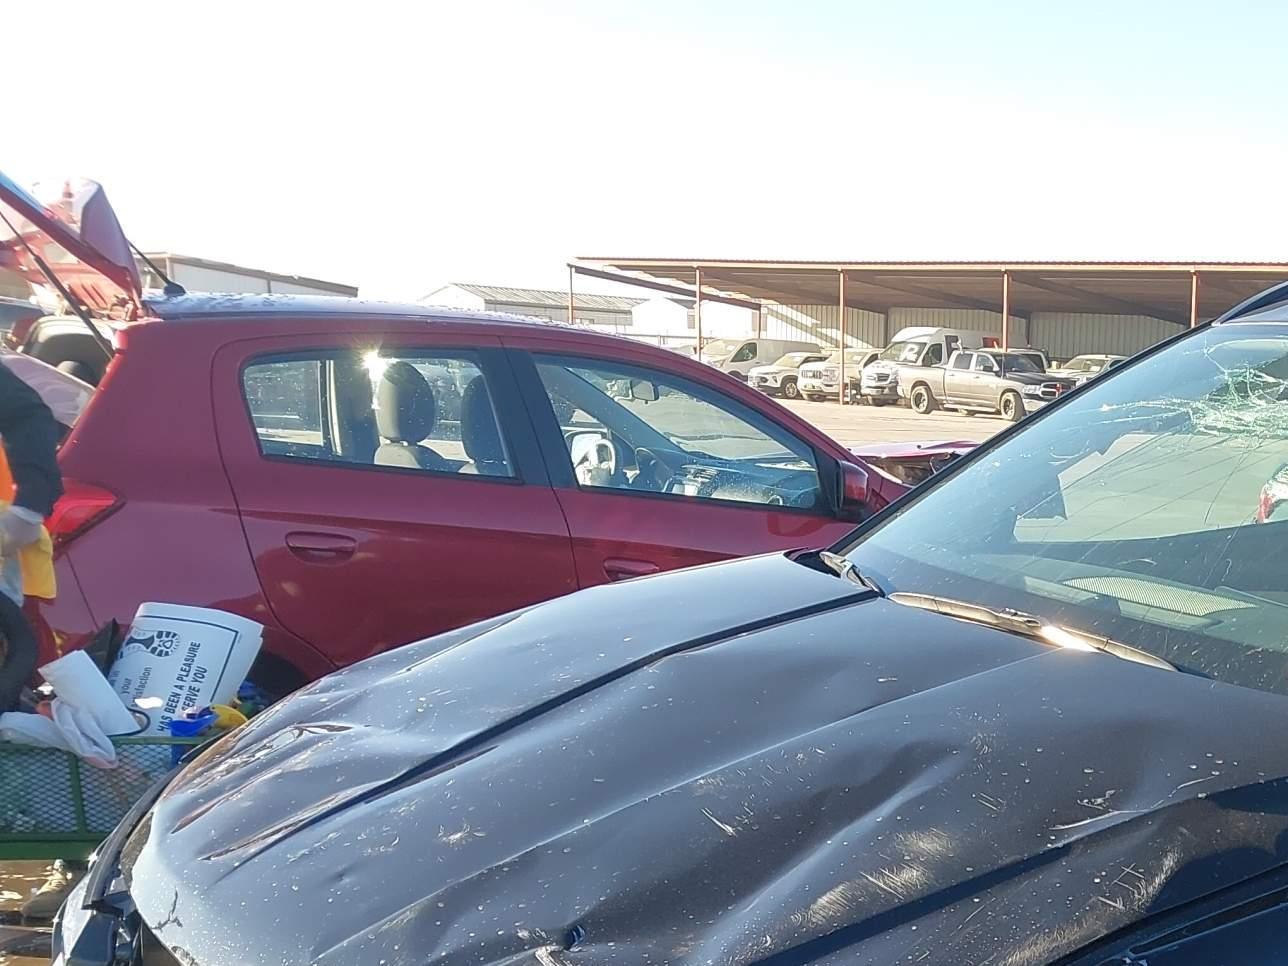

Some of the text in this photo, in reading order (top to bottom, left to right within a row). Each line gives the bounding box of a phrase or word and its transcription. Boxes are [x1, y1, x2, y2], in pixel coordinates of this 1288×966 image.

[191, 666, 208, 685] YOU
[120, 678, 132, 694] your
[156, 641, 201, 732] HAS BEEN A PLEASURE
